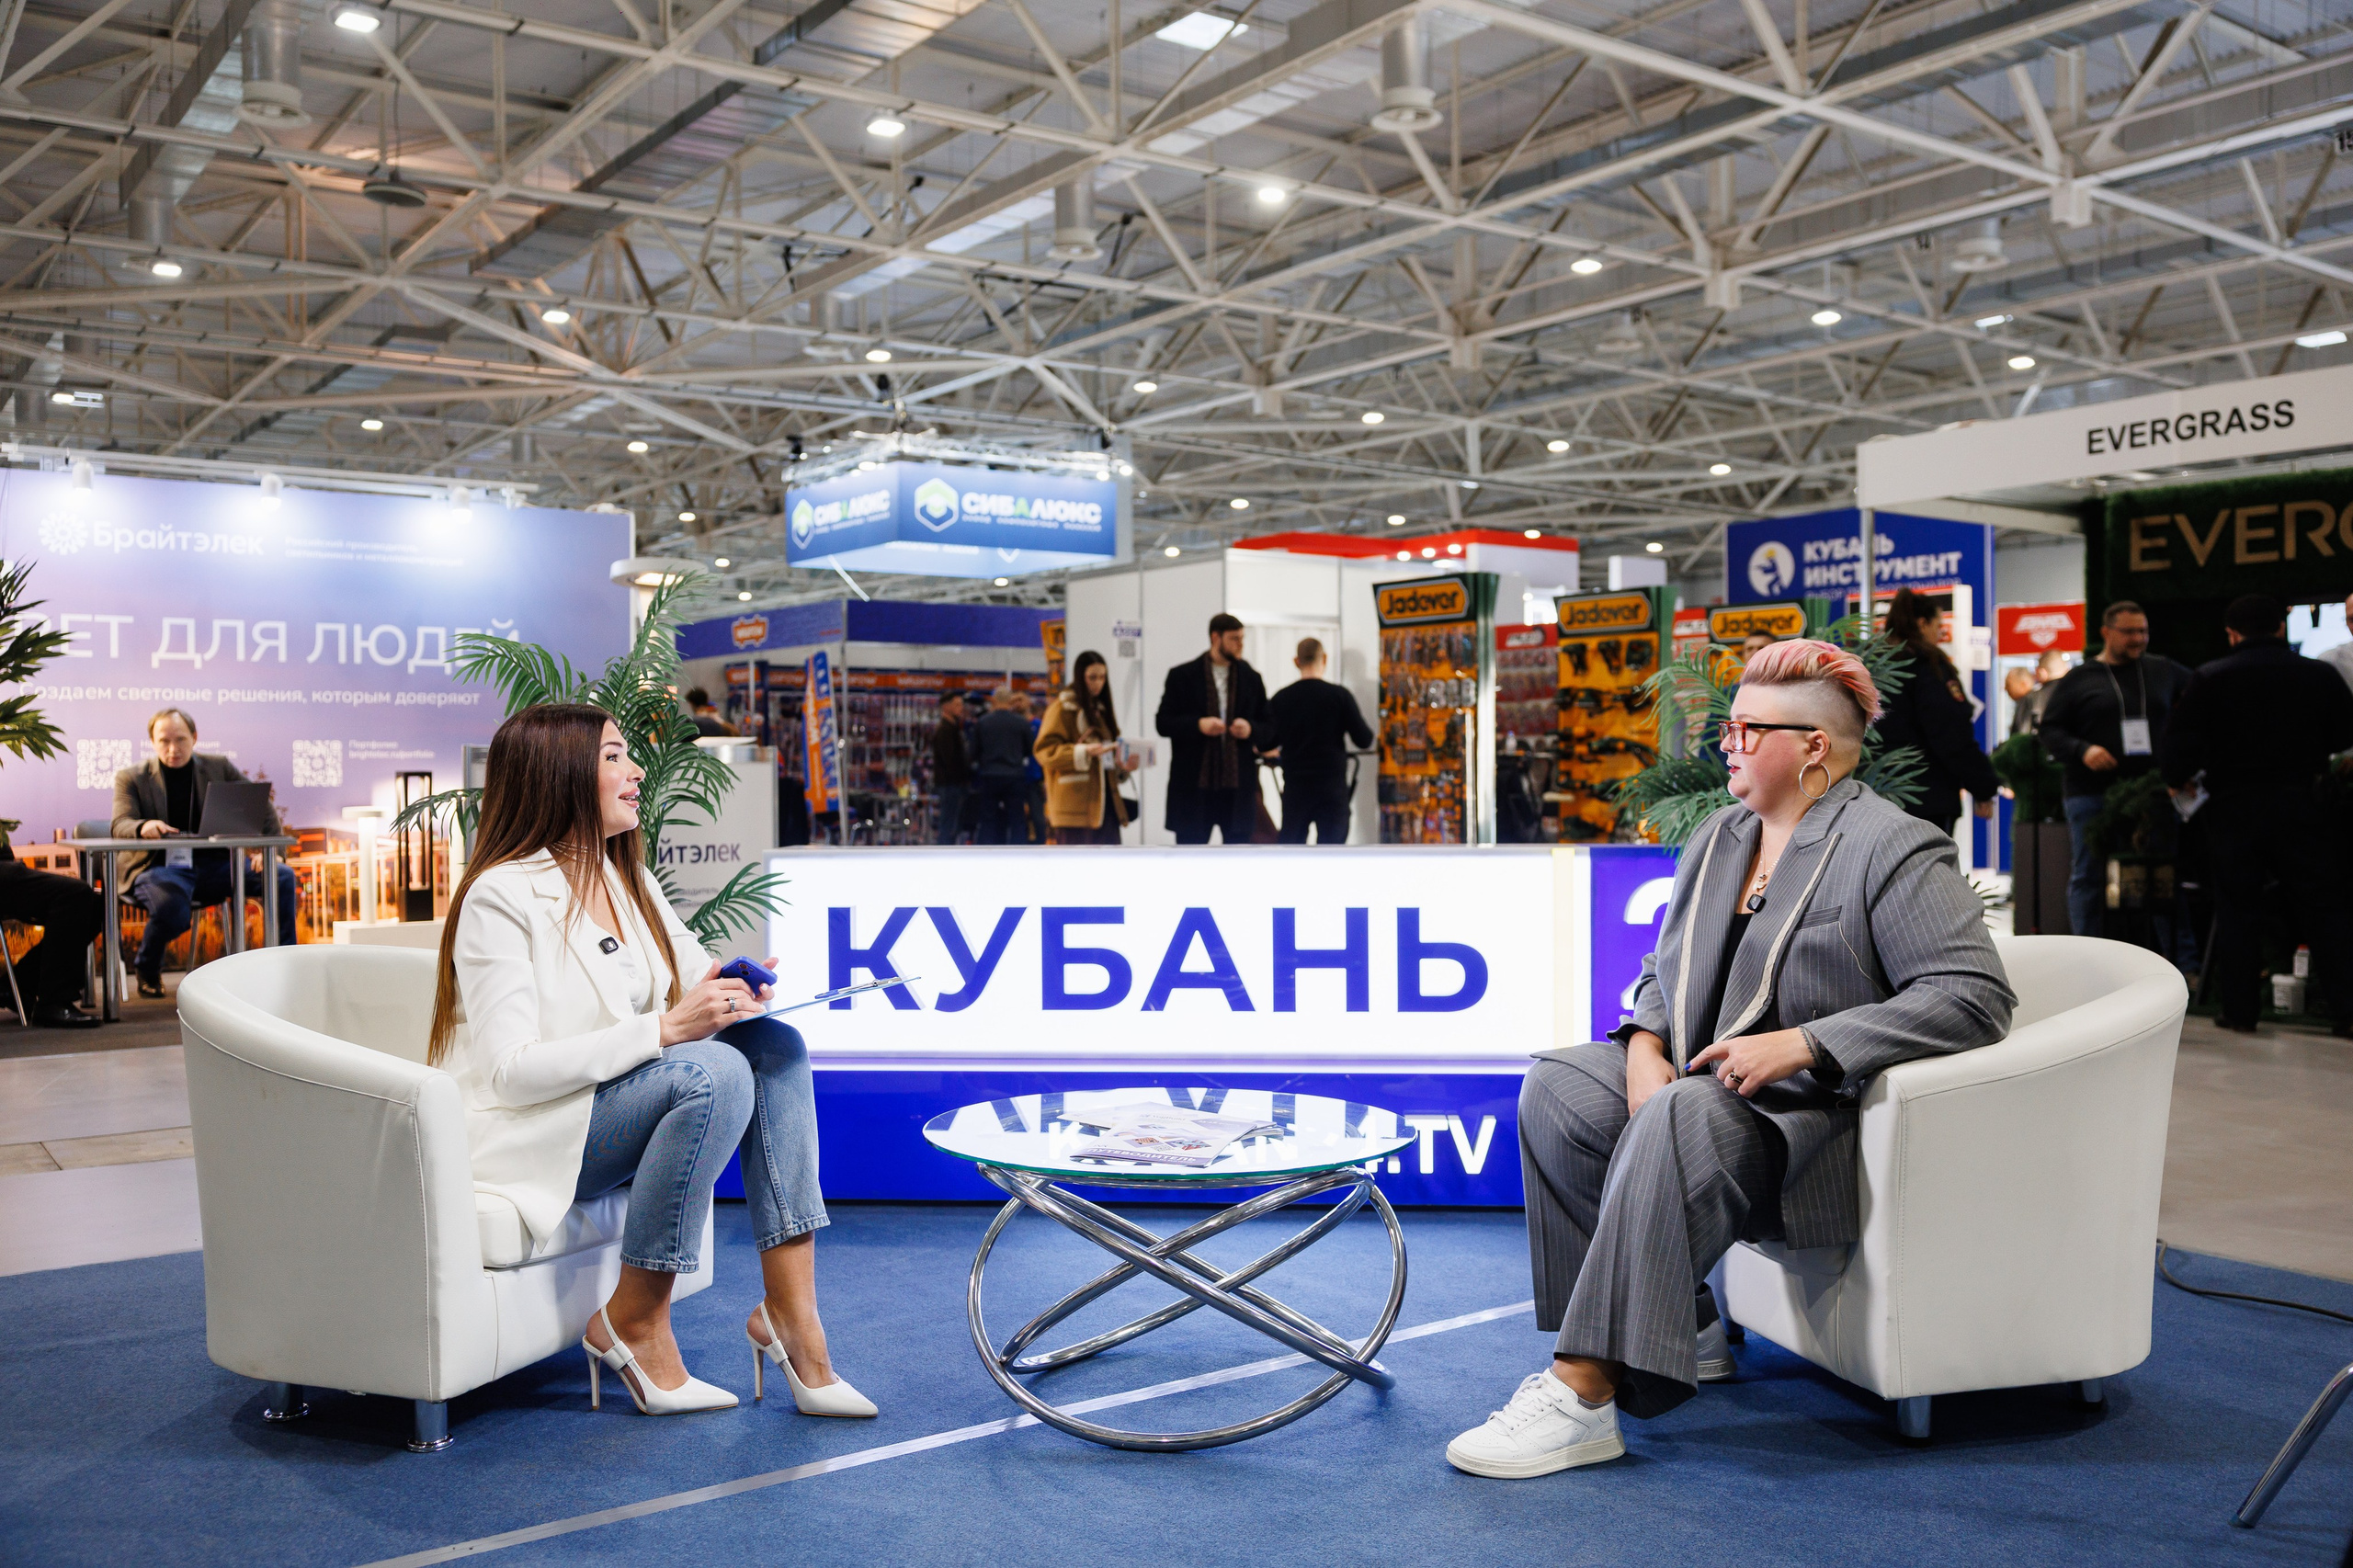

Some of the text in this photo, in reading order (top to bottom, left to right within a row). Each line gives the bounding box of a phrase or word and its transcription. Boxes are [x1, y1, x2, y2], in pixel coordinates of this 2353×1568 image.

[2087, 400, 2295, 454] EVERGRASS
[93, 521, 265, 555] Брайтэлек
[1386, 588, 1459, 615] Jadever
[1566, 602, 1642, 625] Jadever
[151, 617, 287, 670] ДЛЯ
[19, 682, 480, 709] Создаем световые решения, которым доверяют
[658, 837, 740, 864] йтэлек
[827, 906, 1489, 1013] КУБАНЬ
[1086, 1148, 1197, 1163] ПУТЕВОДИТЕЛЬ
